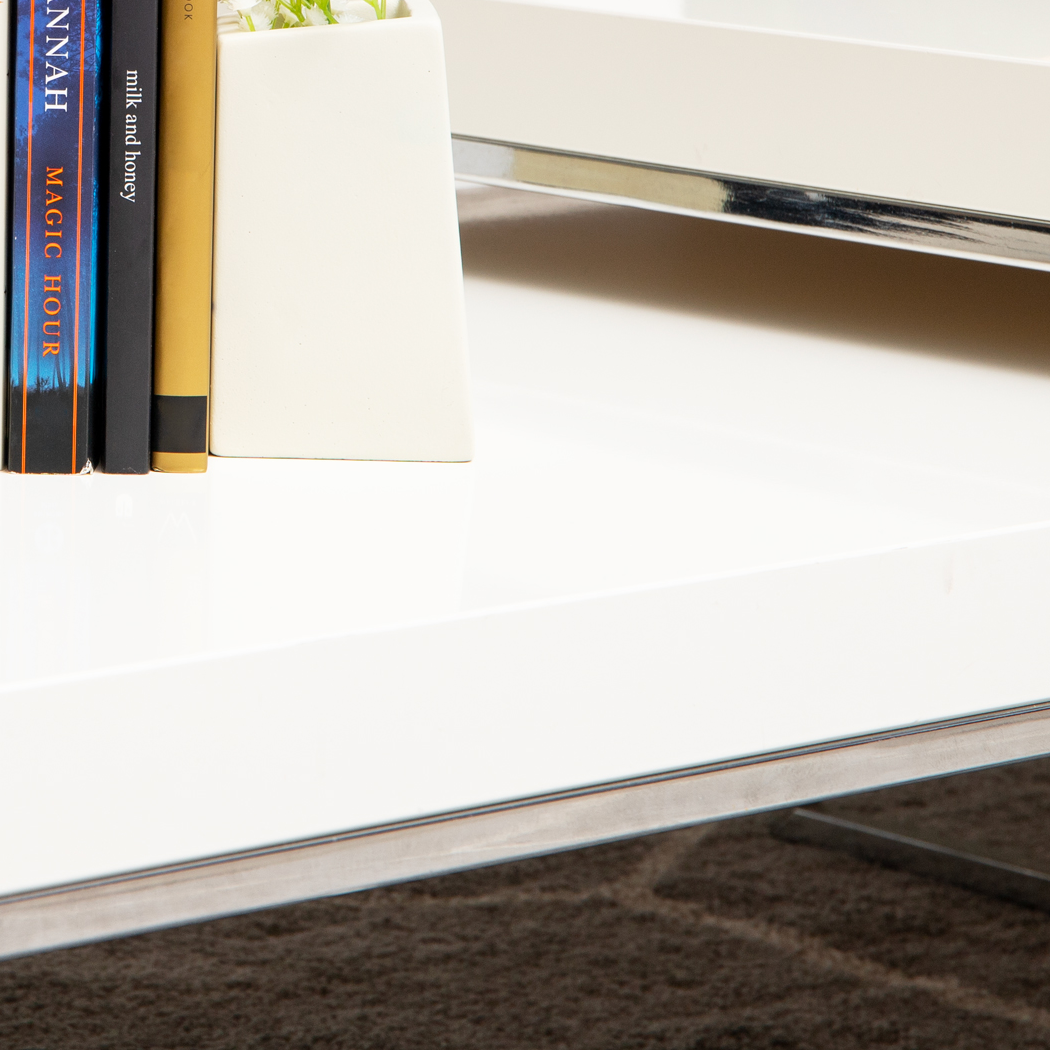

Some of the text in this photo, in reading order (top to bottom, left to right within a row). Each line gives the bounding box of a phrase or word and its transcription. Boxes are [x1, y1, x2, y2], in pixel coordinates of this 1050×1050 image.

[119, 69, 143, 203] milk and honey
[41, 166, 64, 357] MAGIC HOUR
